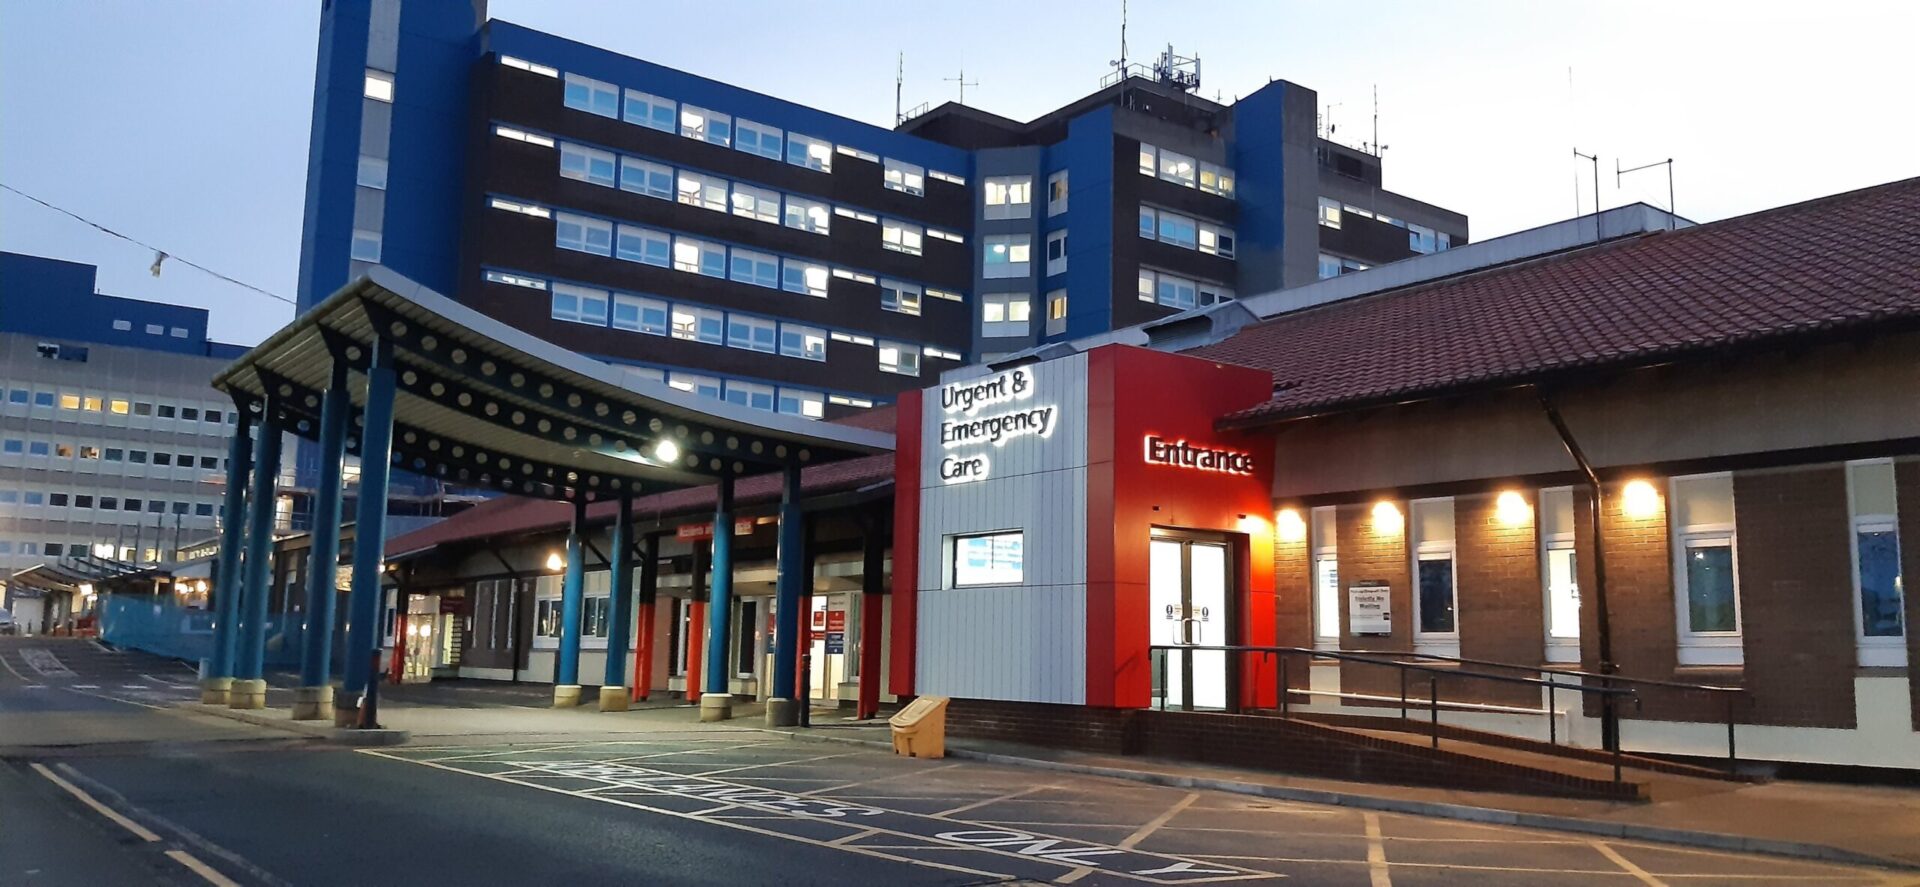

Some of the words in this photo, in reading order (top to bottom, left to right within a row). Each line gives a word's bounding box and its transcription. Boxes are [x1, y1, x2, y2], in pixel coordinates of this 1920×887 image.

[941, 375, 1006, 412] Urgent
[1012, 370, 1028, 394] &
[941, 407, 1052, 444] Emergency
[940, 458, 983, 480] Care
[1145, 435, 1254, 475] Entrance
[934, 830, 1238, 876] ONLY
